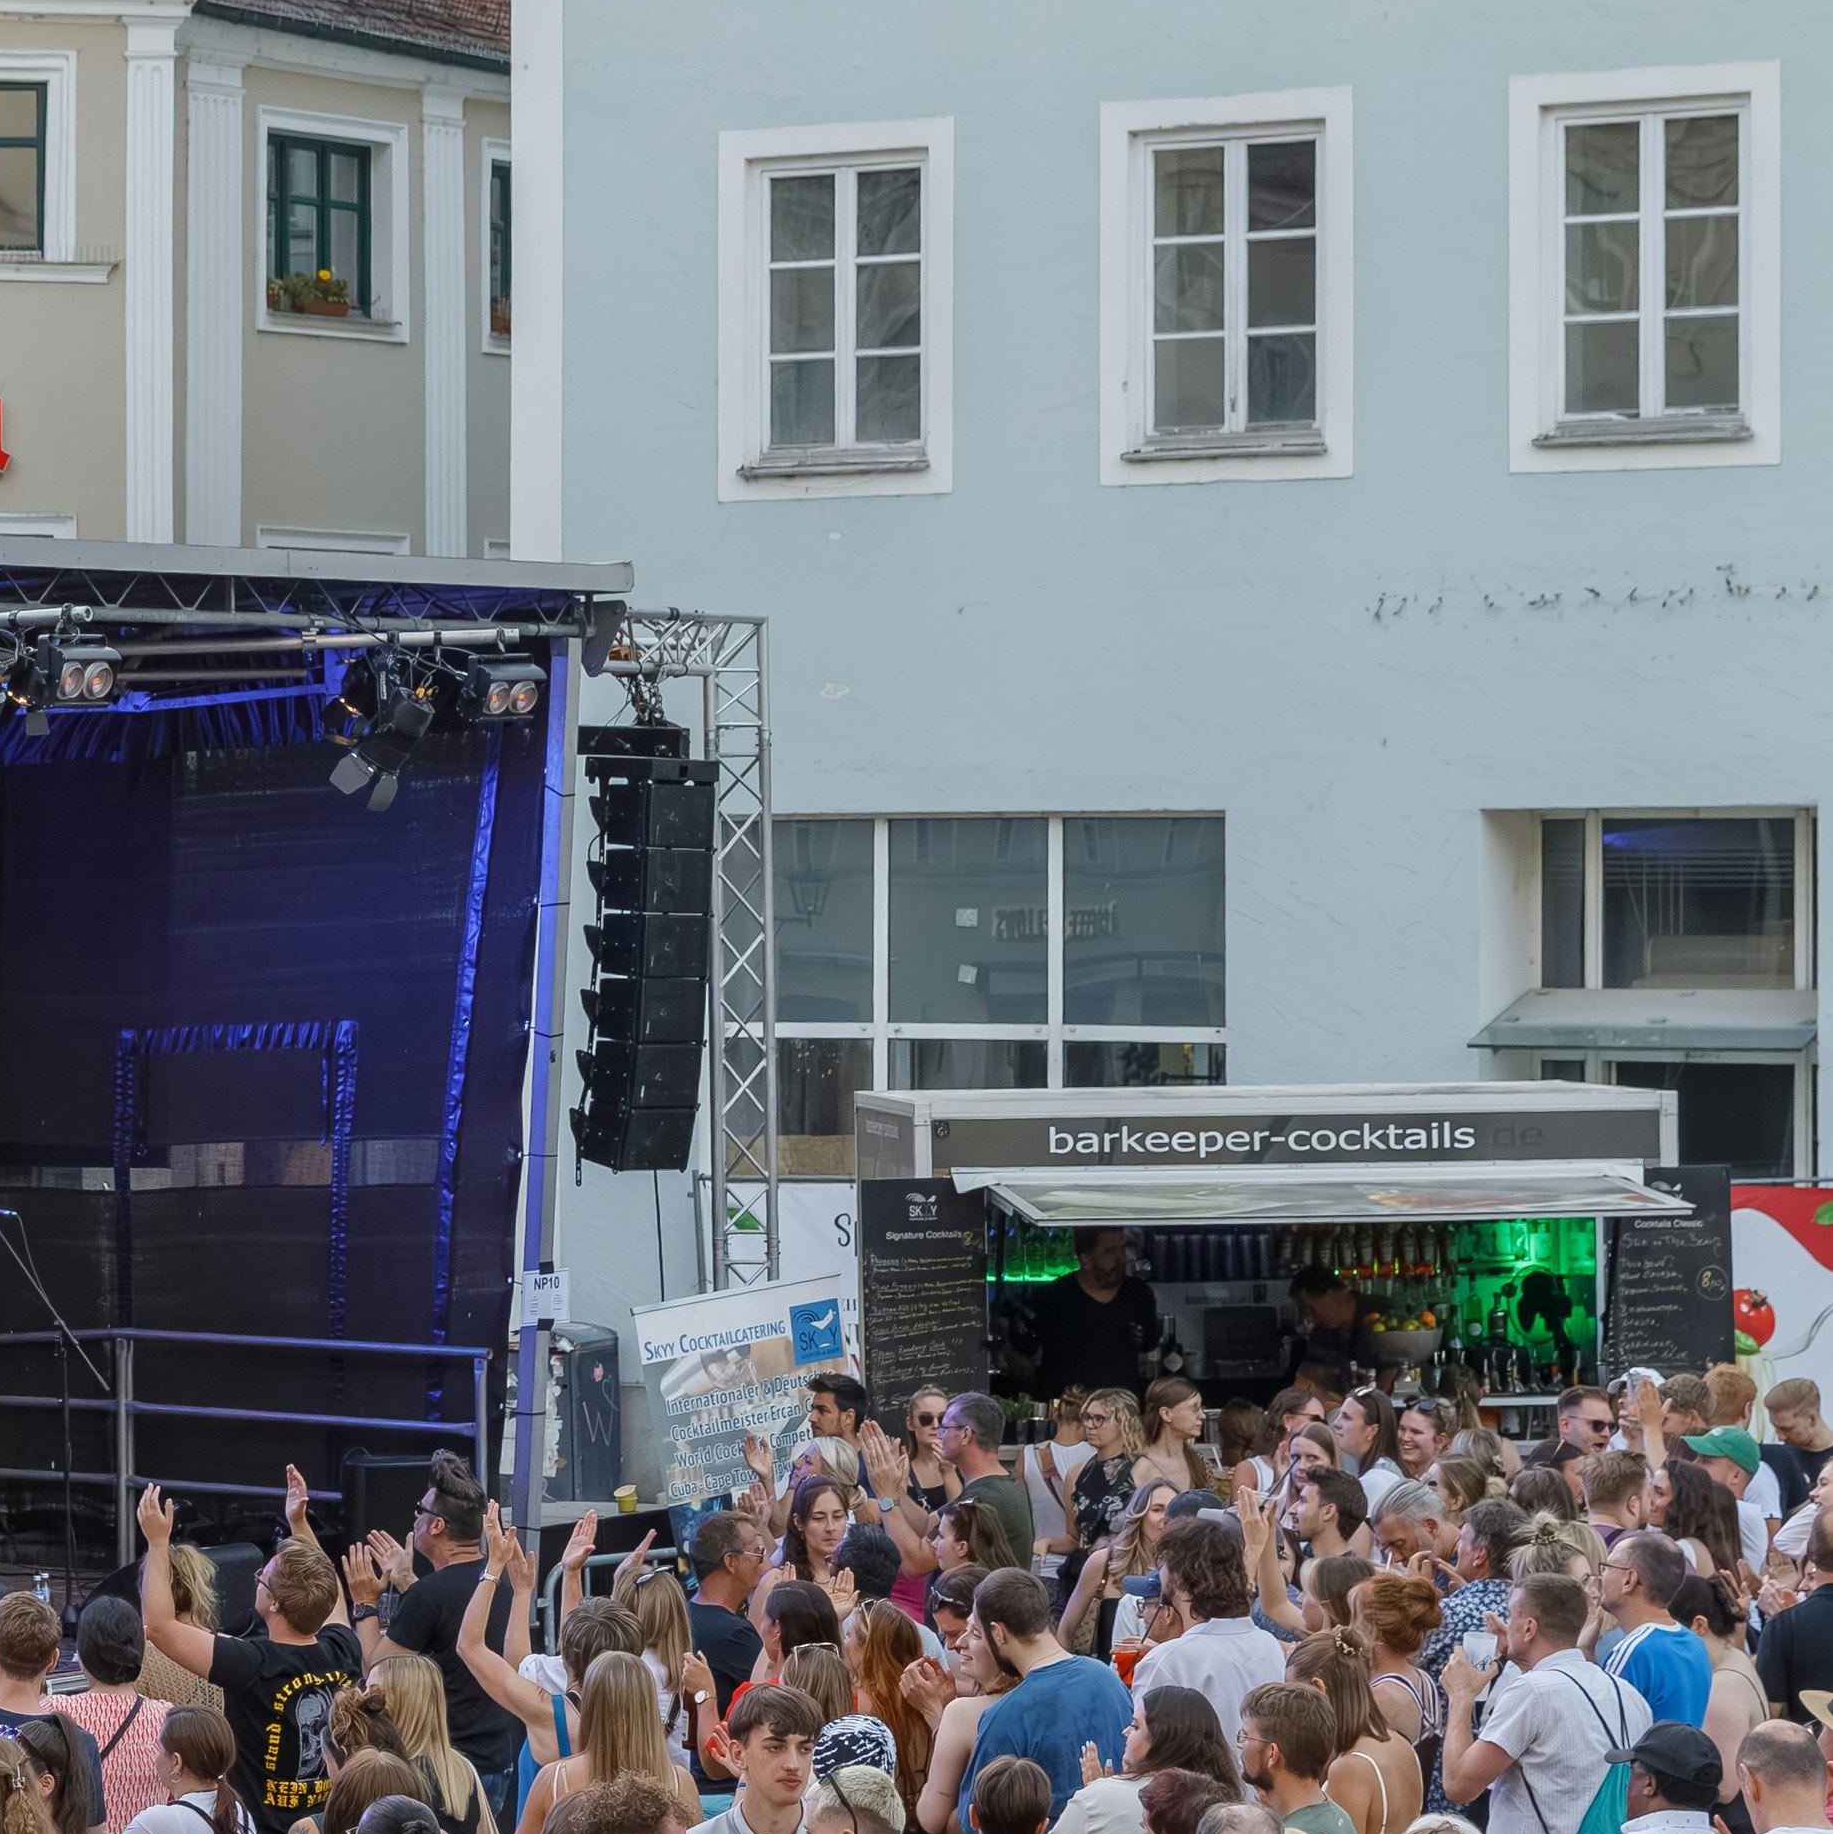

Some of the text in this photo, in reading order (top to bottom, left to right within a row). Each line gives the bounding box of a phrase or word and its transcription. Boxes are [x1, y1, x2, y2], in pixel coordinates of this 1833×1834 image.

[1049, 1121, 1476, 1158] barkeeper-cocktails
[533, 1276, 560, 1290] NP10
[667, 1384, 759, 1416] Internationaler
[670, 1410, 769, 1442] Cocktailmeister
[769, 1402, 802, 1422] Ercan
[674, 1447, 712, 1468] World
[670, 1480, 698, 1498] Cuba
[704, 1474, 731, 1491] Cape
